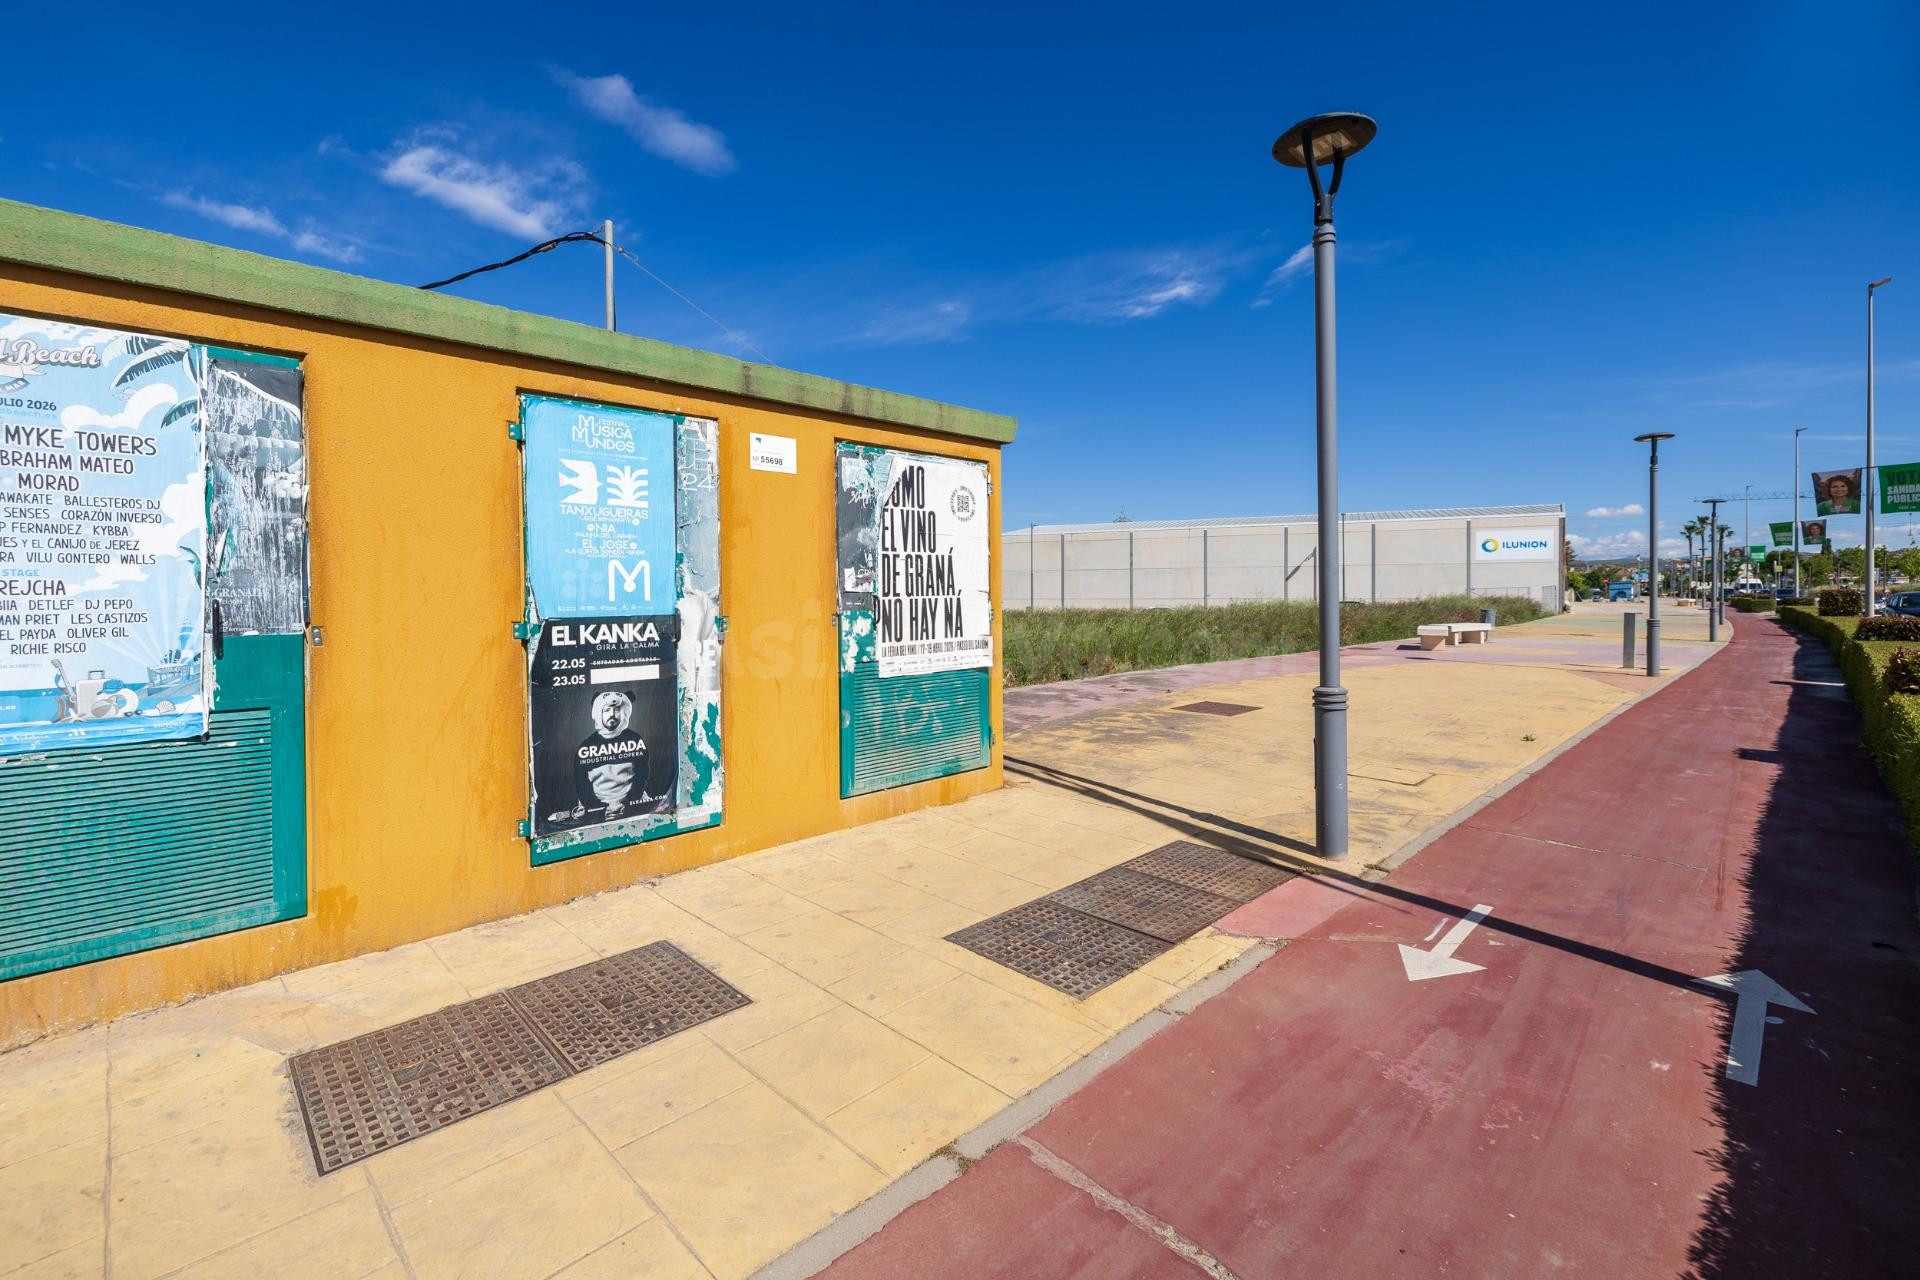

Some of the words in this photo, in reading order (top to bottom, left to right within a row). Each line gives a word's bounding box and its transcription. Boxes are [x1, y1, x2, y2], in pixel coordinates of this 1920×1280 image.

[11, 339, 100, 368] Beach
[0, 398, 23, 408] LIO
[27, 399, 57, 411] 2026
[5, 424, 64, 448] MYKE
[74, 430, 157, 456] TOWERS
[572, 425, 636, 453] MUNDOS
[80, 455, 134, 475] MATEO
[18, 472, 80, 491] MORAD
[884, 465, 926, 509] OMO
[64, 495, 143, 510] BALLESTEROS
[146, 499, 161, 510] DJ
[4, 506, 50, 519] SENSES
[61, 509, 112, 522] CORAZÓN
[116, 511, 162, 524] INVERSO
[559, 504, 649, 519] TANXUGUEIRAS
[11, 522, 82, 535] FERNANDEZ
[93, 525, 129, 537] KYBBA
[881, 508, 897, 552] EL
[900, 509, 937, 553] VINO
[0, 536, 18, 548] ES
[21, 539, 28, 548] Y
[32, 539, 44, 549] EL
[47, 537, 87, 549] CANIJO
[89, 540, 101, 549] DE
[105, 539, 140, 551] JEREZ
[582, 539, 596, 549] EL
[599, 540, 629, 550] JOSE
[1502, 540, 1547, 549] ILUNION
[26, 552, 52, 563] VILU
[57, 552, 110, 564] GONTERO
[120, 554, 156, 565] WALLS
[2, 568, 40, 577] STAGE
[882, 553, 900, 597] DE
[905, 547, 955, 597] GRANÁ
[28, 599, 74, 610] DETLEF
[85, 599, 100, 610] DJ
[104, 599, 133, 610] PEPO
[25, 613, 60, 625] PRIET
[71, 613, 93, 625] LES
[97, 612, 148, 624] CASTIZOS
[882, 598, 903, 643] NO
[910, 597, 938, 641] HAY
[944, 589, 963, 638] NÁ
[19, 628, 56, 640] PAYDA
[67, 627, 107, 639] OLIVER
[111, 627, 130, 638] GIL
[551, 625, 577, 646] EL
[580, 622, 660, 645] KANKA
[10, 643, 49, 655] RICHIE
[54, 642, 87, 654] RISCO
[632, 641, 660, 649] CALMA
[887, 645, 899, 657] FERIA
[551, 658, 586, 670] 22.05
[552, 674, 586, 687] 23.05
[578, 739, 647, 759] GRANADA
[580, 756, 616, 765] INDUSTRIAL
[618, 751, 644, 760] COPERA
